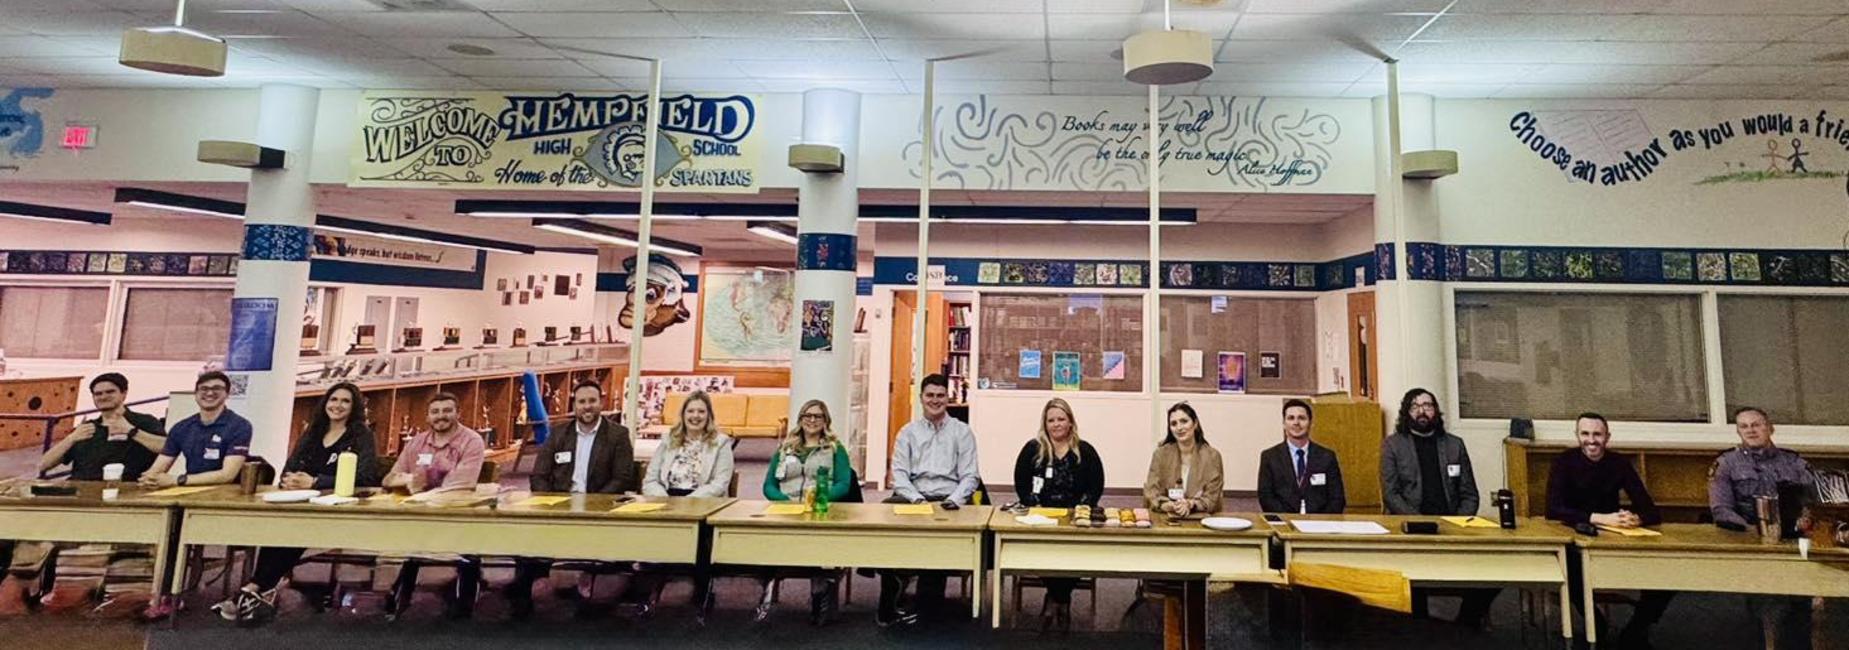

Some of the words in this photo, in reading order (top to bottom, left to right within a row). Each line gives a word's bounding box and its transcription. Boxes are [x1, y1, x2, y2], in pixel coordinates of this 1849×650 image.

[364, 107, 500, 164] WELCOME
[500, 95, 754, 142] HEMPFIELD
[1061, 110, 1109, 131] Books
[1109, 121, 1138, 143] may
[1143, 122, 1169, 138] vy
[1174, 109, 1214, 133] well
[434, 144, 473, 167] TO
[534, 138, 571, 156] HIGH
[693, 139, 742, 157] SCHOOL
[1096, 138, 1113, 160] be
[1115, 136, 1142, 160] the
[1140, 139, 1171, 168] oly
[1174, 148, 1203, 160] true
[1205, 148, 1248, 176] magic
[1510, 111, 1572, 170] Choose
[1572, 158, 1597, 184] an
[1601, 137, 1668, 187] author
[1669, 128, 1696, 151] as
[1698, 120, 1735, 149] you
[1742, 112, 1793, 137] would
[1799, 118, 1809, 134] a
[1815, 109, 1849, 151] frie
[495, 158, 547, 184] Home
[549, 164, 568, 187] of
[569, 164, 594, 184] the
[670, 167, 753, 187] SPARTANS
